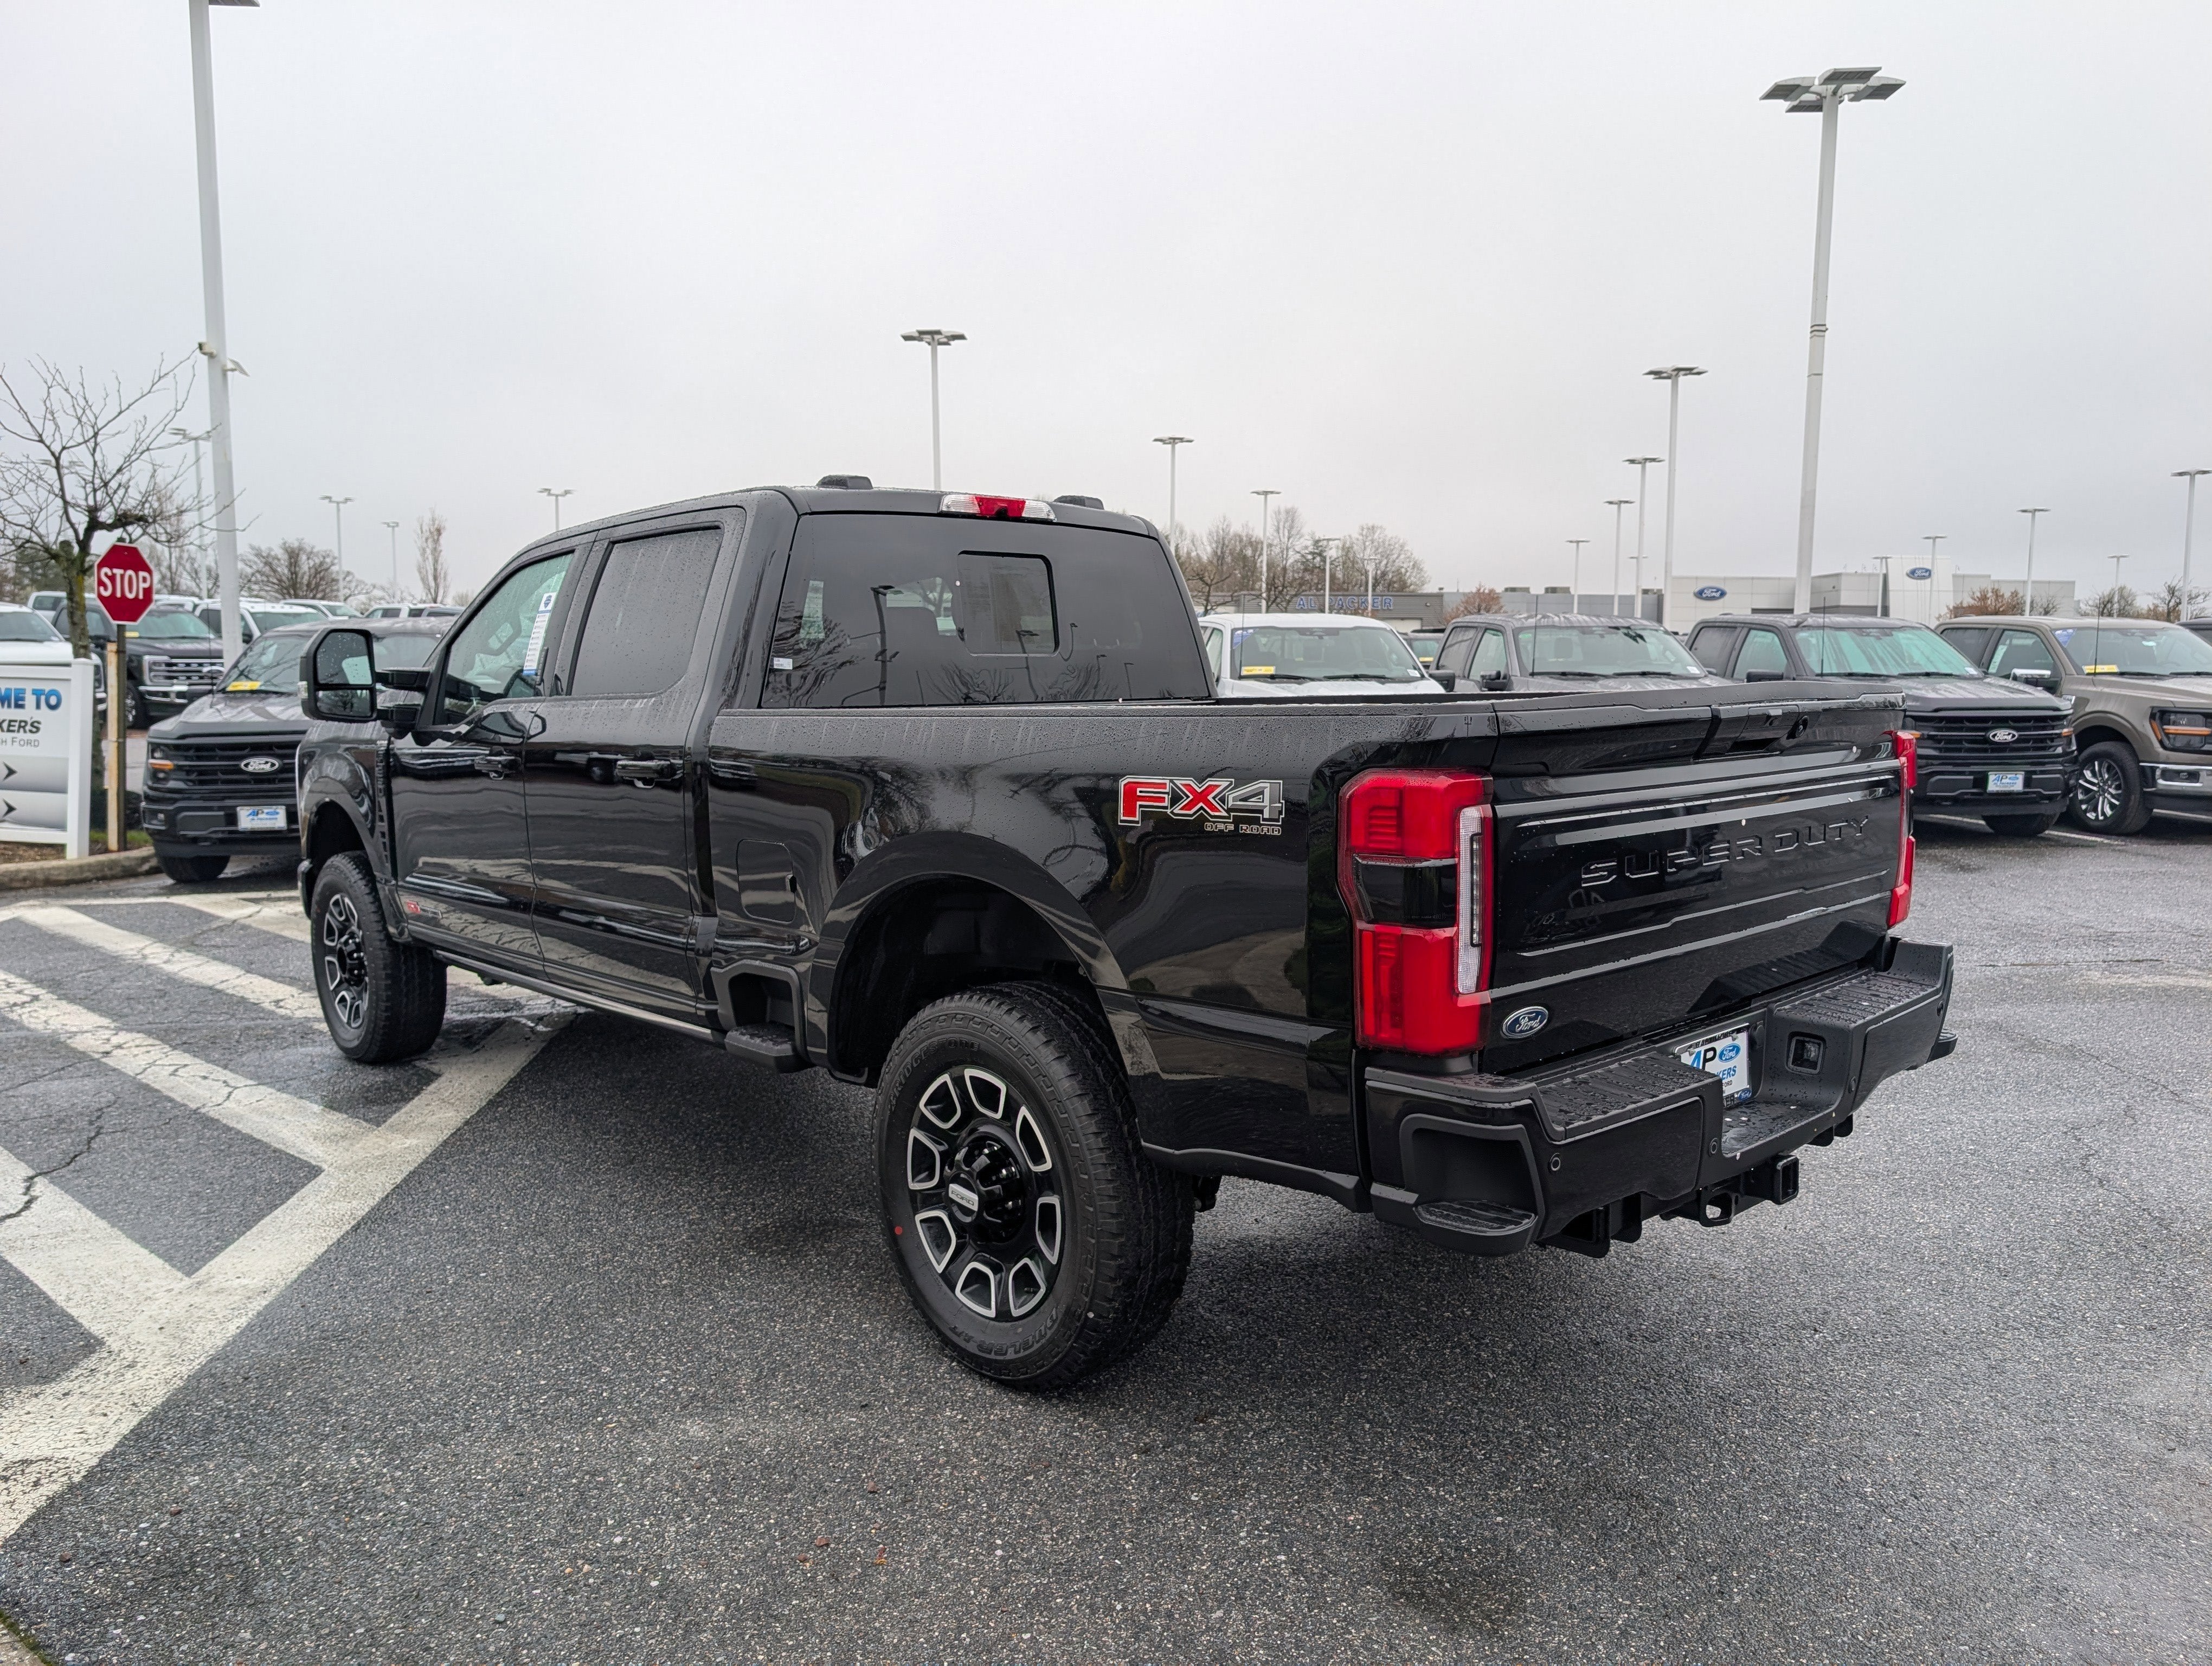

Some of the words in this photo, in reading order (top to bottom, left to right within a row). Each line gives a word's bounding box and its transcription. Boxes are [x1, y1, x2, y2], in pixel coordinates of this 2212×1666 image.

[99, 567, 151, 600] STOP
[1296, 597, 1317, 609] AL
[1328, 596, 1393, 610] PACKER
[31, 688, 62, 711] TO
[11, 736, 40, 748] FORD
[1118, 776, 1284, 826] FX4
[1204, 822, 1234, 832] OFF
[1239, 824, 1282, 836] ROAD
[1581, 834, 1763, 887] SUPER
[1774, 815, 1869, 853] DUTY
[1515, 1013, 1542, 1032] Ford
[951, 1190, 974, 1206] FORD
[977, 1308, 1058, 1357] DUELER
